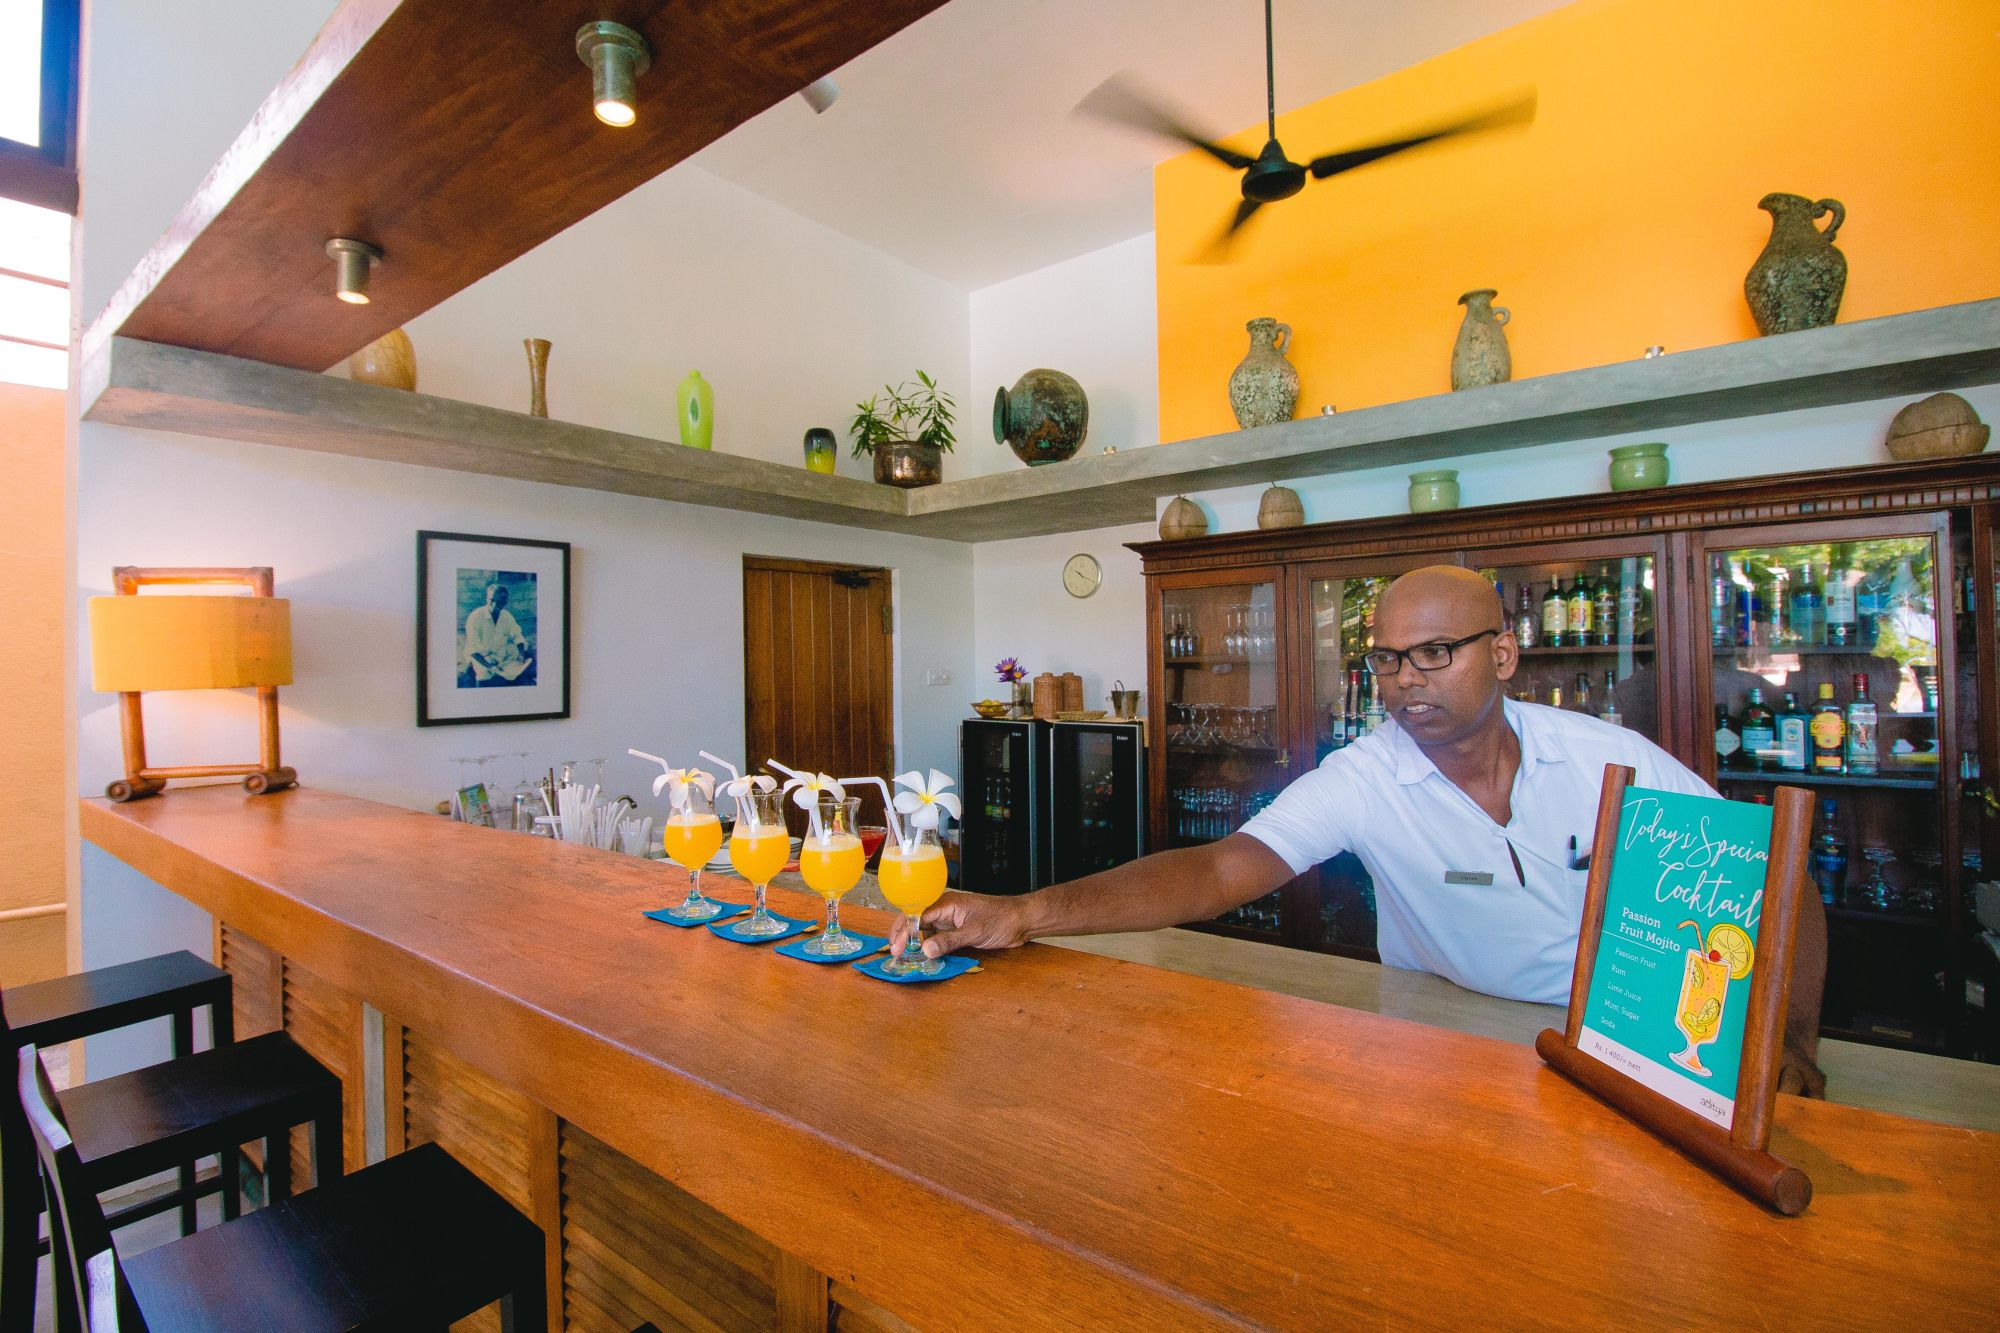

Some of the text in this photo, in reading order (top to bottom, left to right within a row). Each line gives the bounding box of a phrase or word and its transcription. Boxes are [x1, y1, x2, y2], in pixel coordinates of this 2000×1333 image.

[1621, 798, 1769, 868] Today's Specia
[1655, 860, 1763, 928] Cocktail
[1622, 906, 1661, 929] Passion
[1619, 922, 1681, 952] Fruit Mojito
[1615, 947, 1656, 969] Passion Fruit
[1611, 964, 1626, 977] Rum
[1607, 981, 1642, 1002] Lime Juice
[1600, 1015, 1616, 1029] Soda
[1621, 1006, 1640, 1021] Sugar
